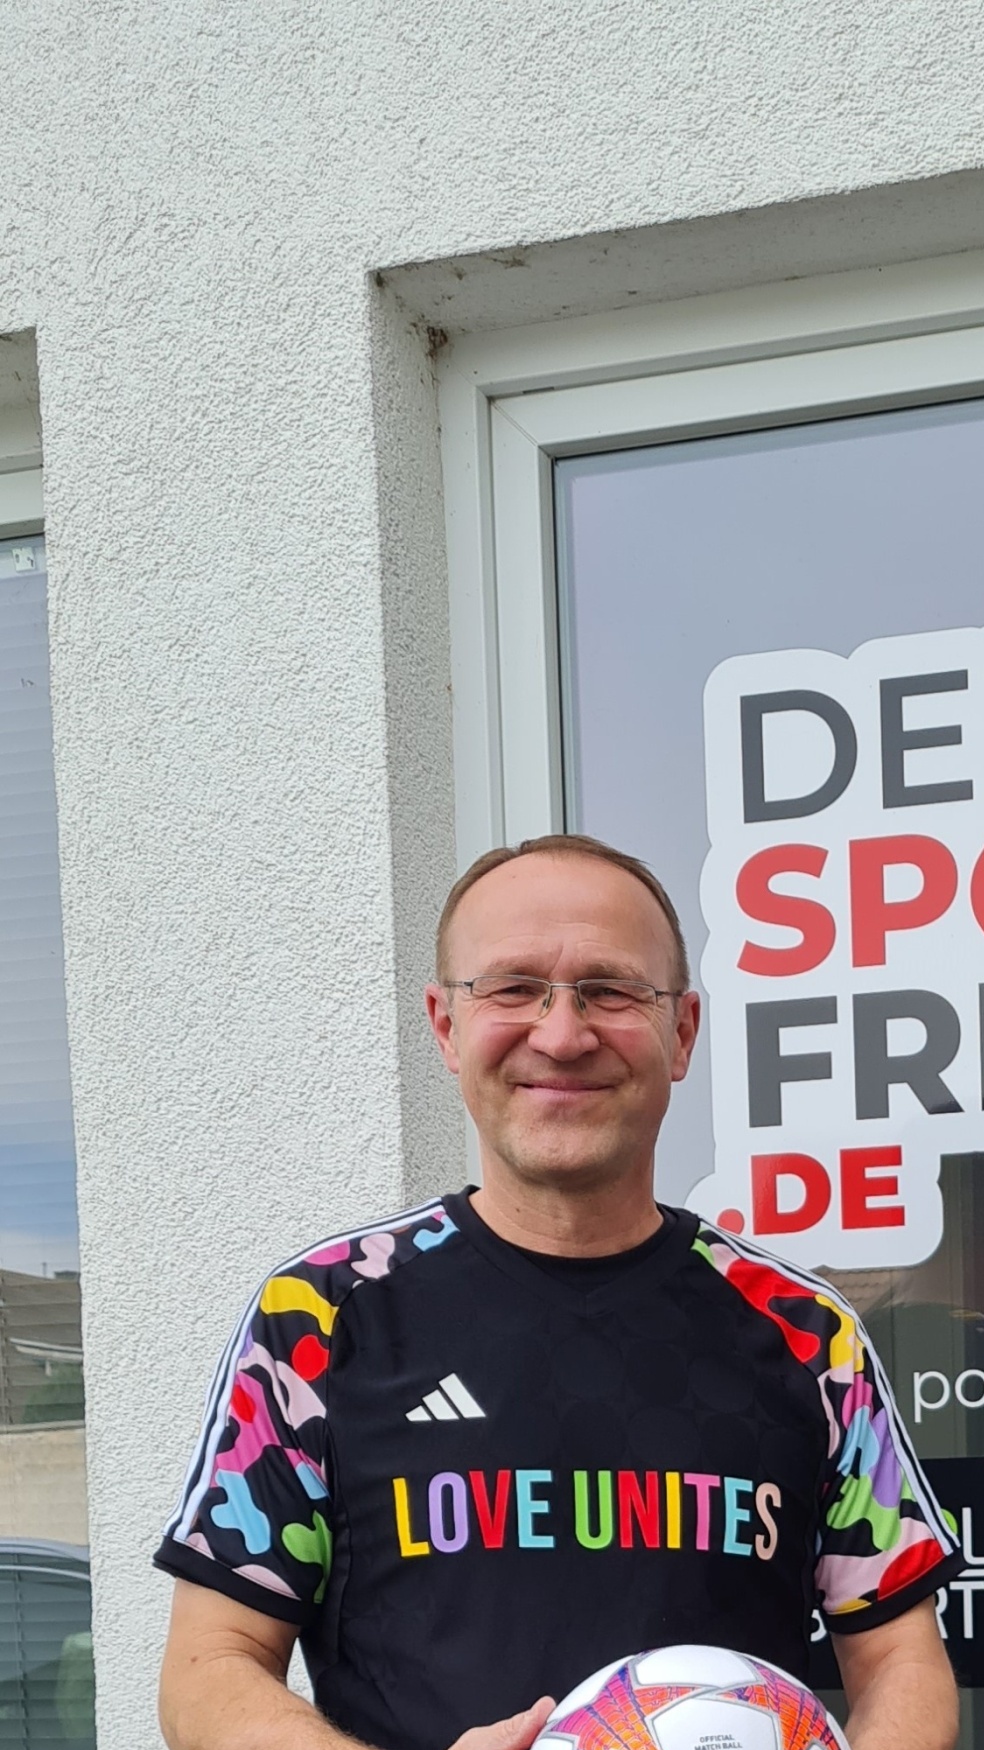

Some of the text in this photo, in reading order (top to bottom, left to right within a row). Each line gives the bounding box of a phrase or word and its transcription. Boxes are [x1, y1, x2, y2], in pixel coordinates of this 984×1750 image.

[393, 1469, 782, 1560] LOVE UNITES
[699, 1734, 736, 1744] OFFICIAL
[722, 1741, 743, 1750] BALL
